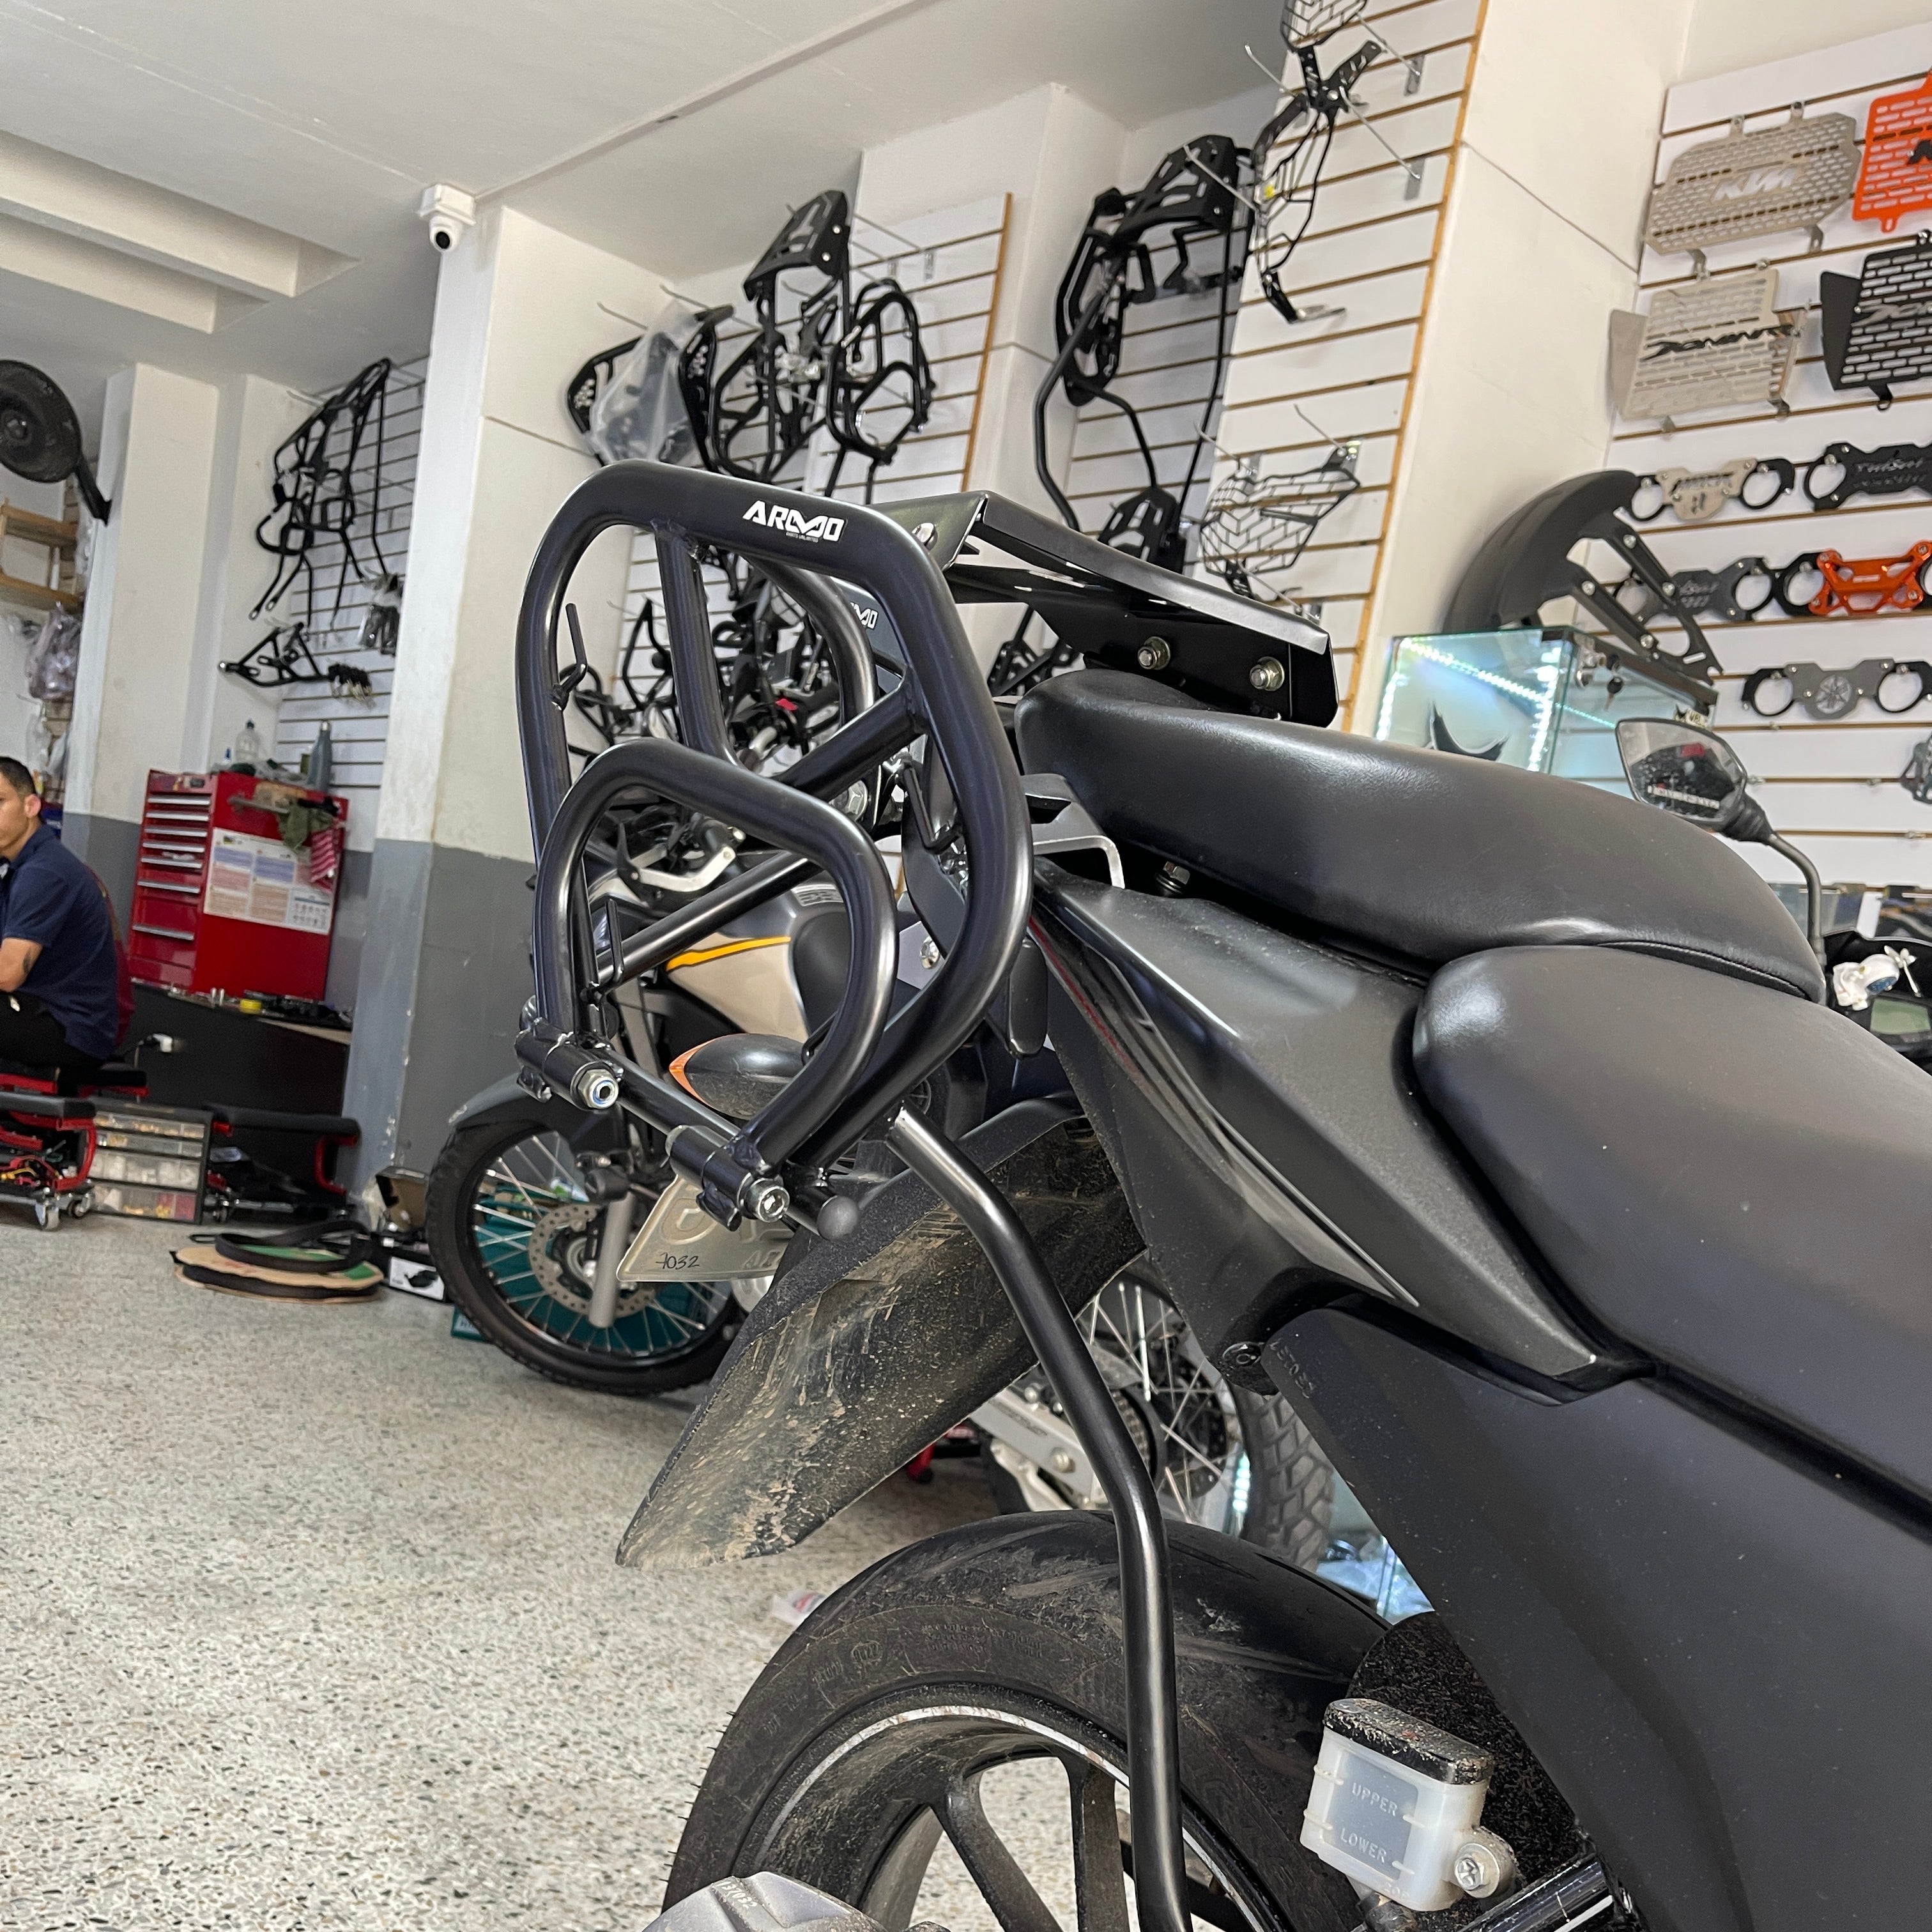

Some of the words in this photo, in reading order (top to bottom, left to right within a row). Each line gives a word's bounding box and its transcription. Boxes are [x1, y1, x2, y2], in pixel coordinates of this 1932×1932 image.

[1711, 166, 1798, 202] KTM
[656, 1252, 700, 1270] 7032
[1352, 1782, 1398, 1817] UPPER
[1340, 1827, 1387, 1863] LOWER
